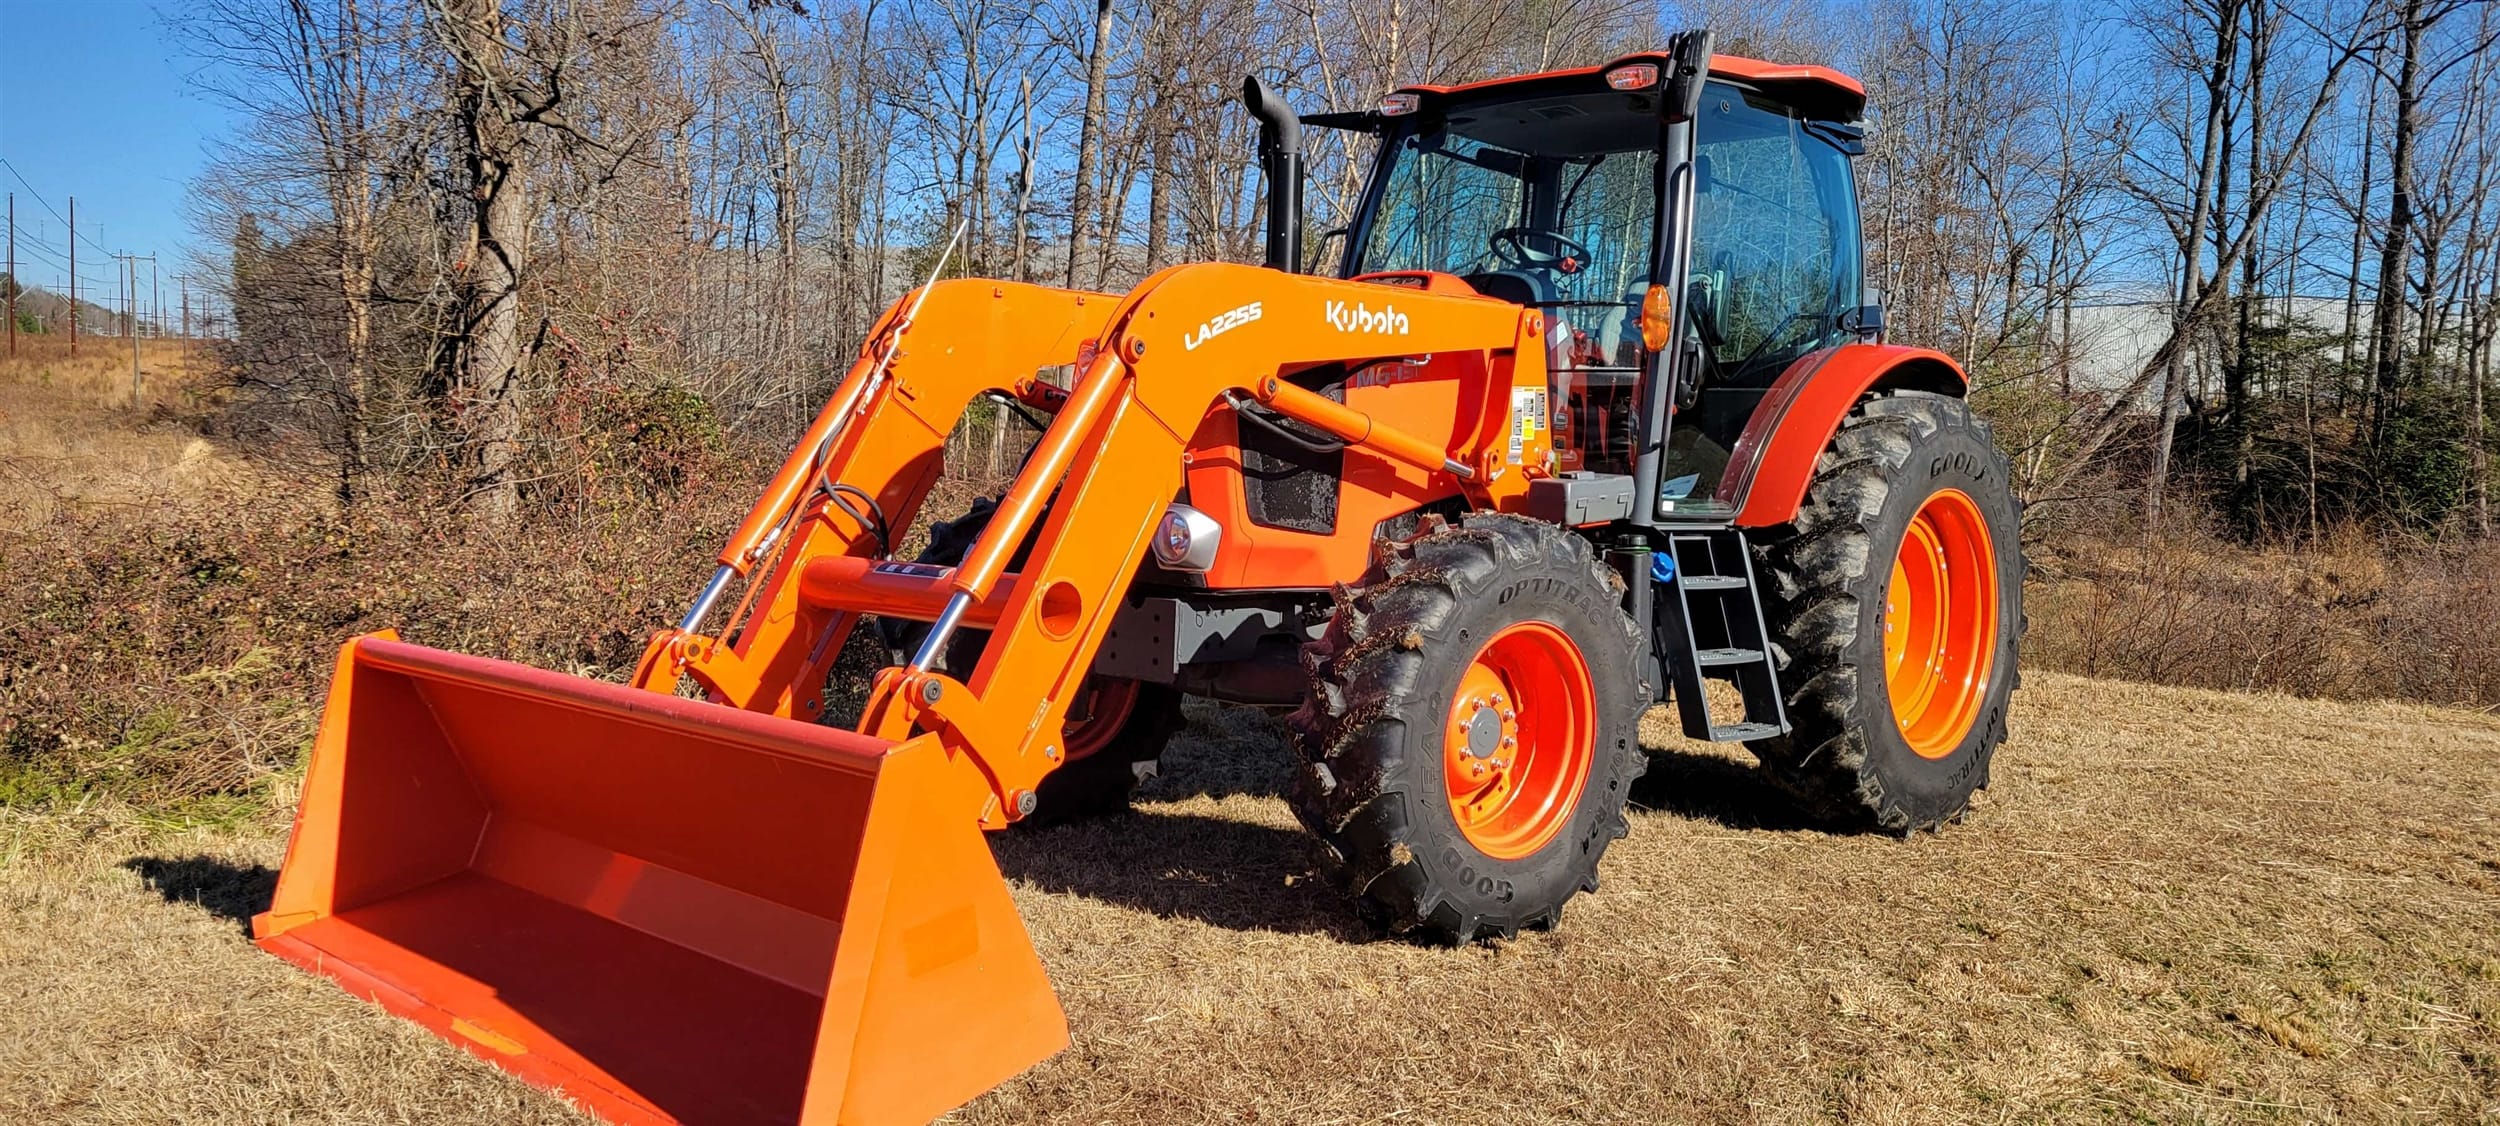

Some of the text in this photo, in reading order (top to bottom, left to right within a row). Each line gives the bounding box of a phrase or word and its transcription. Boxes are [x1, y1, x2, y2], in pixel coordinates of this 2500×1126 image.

[1184, 302, 1262, 350] LA2255
[1325, 300, 1409, 335] Kubota
[1498, 576, 1602, 626] OPTITRAC
[1946, 706, 1999, 790] OPTITRAC
